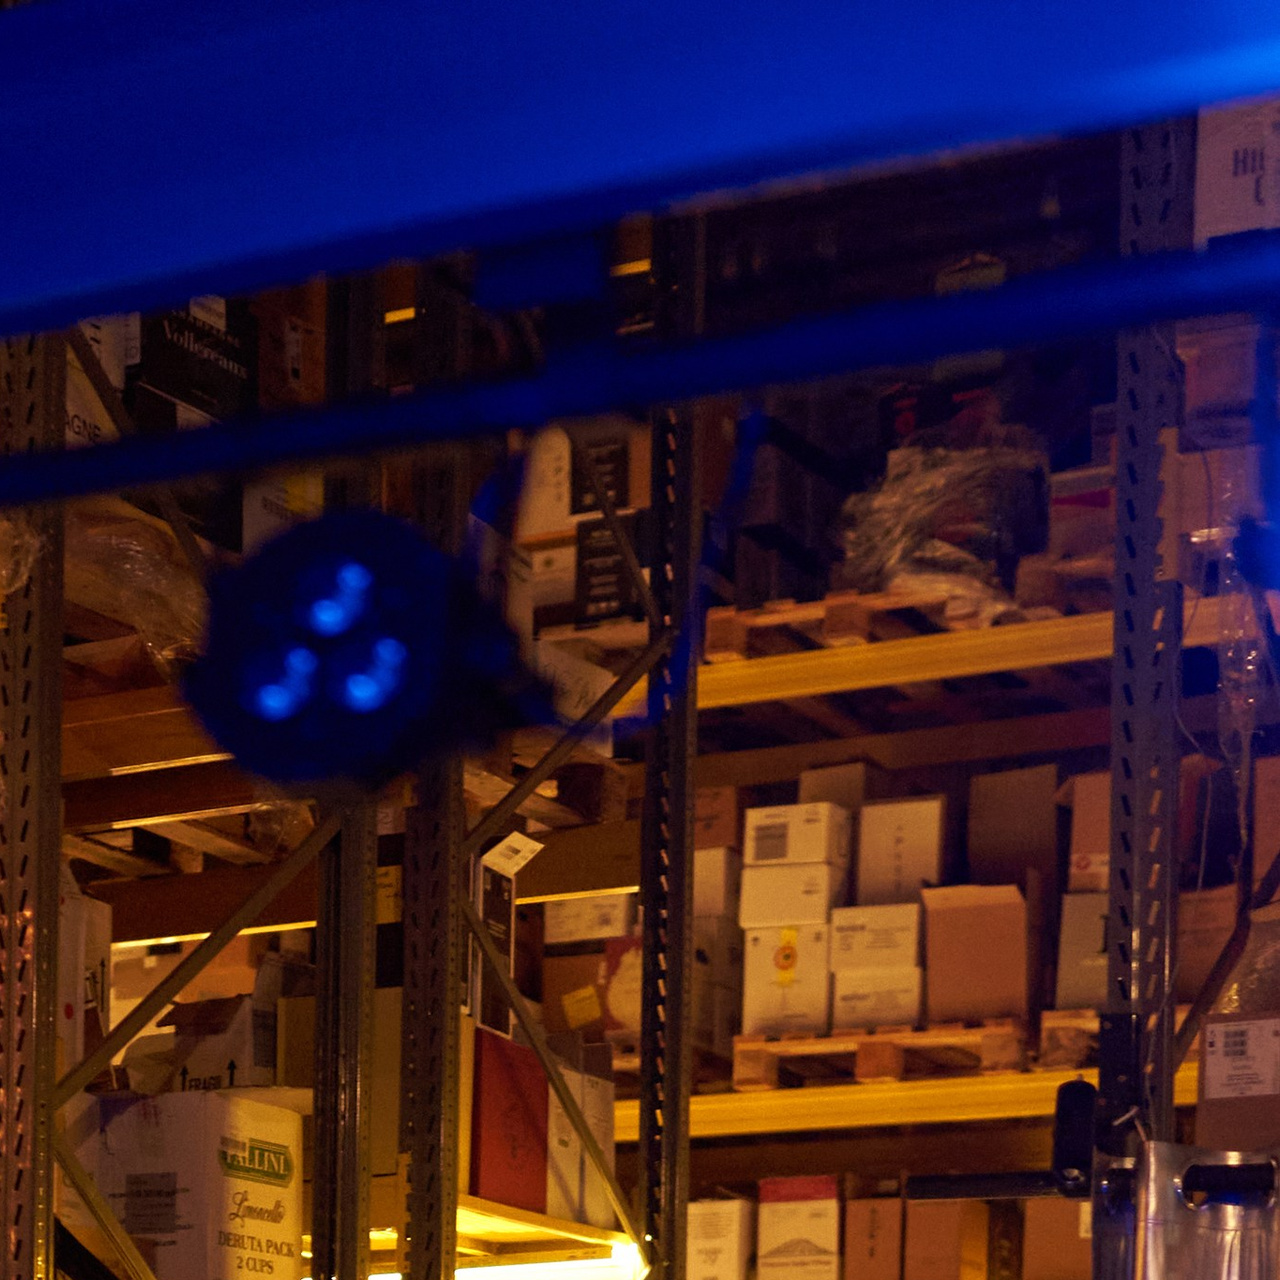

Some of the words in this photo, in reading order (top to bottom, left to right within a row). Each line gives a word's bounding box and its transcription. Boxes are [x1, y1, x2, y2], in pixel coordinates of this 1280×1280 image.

[217, 1230, 264, 1253] DERUTA
[266, 1238, 295, 1258] PACK
[236, 1255, 244, 1269] 2
[245, 1256, 274, 1275] CUPS
